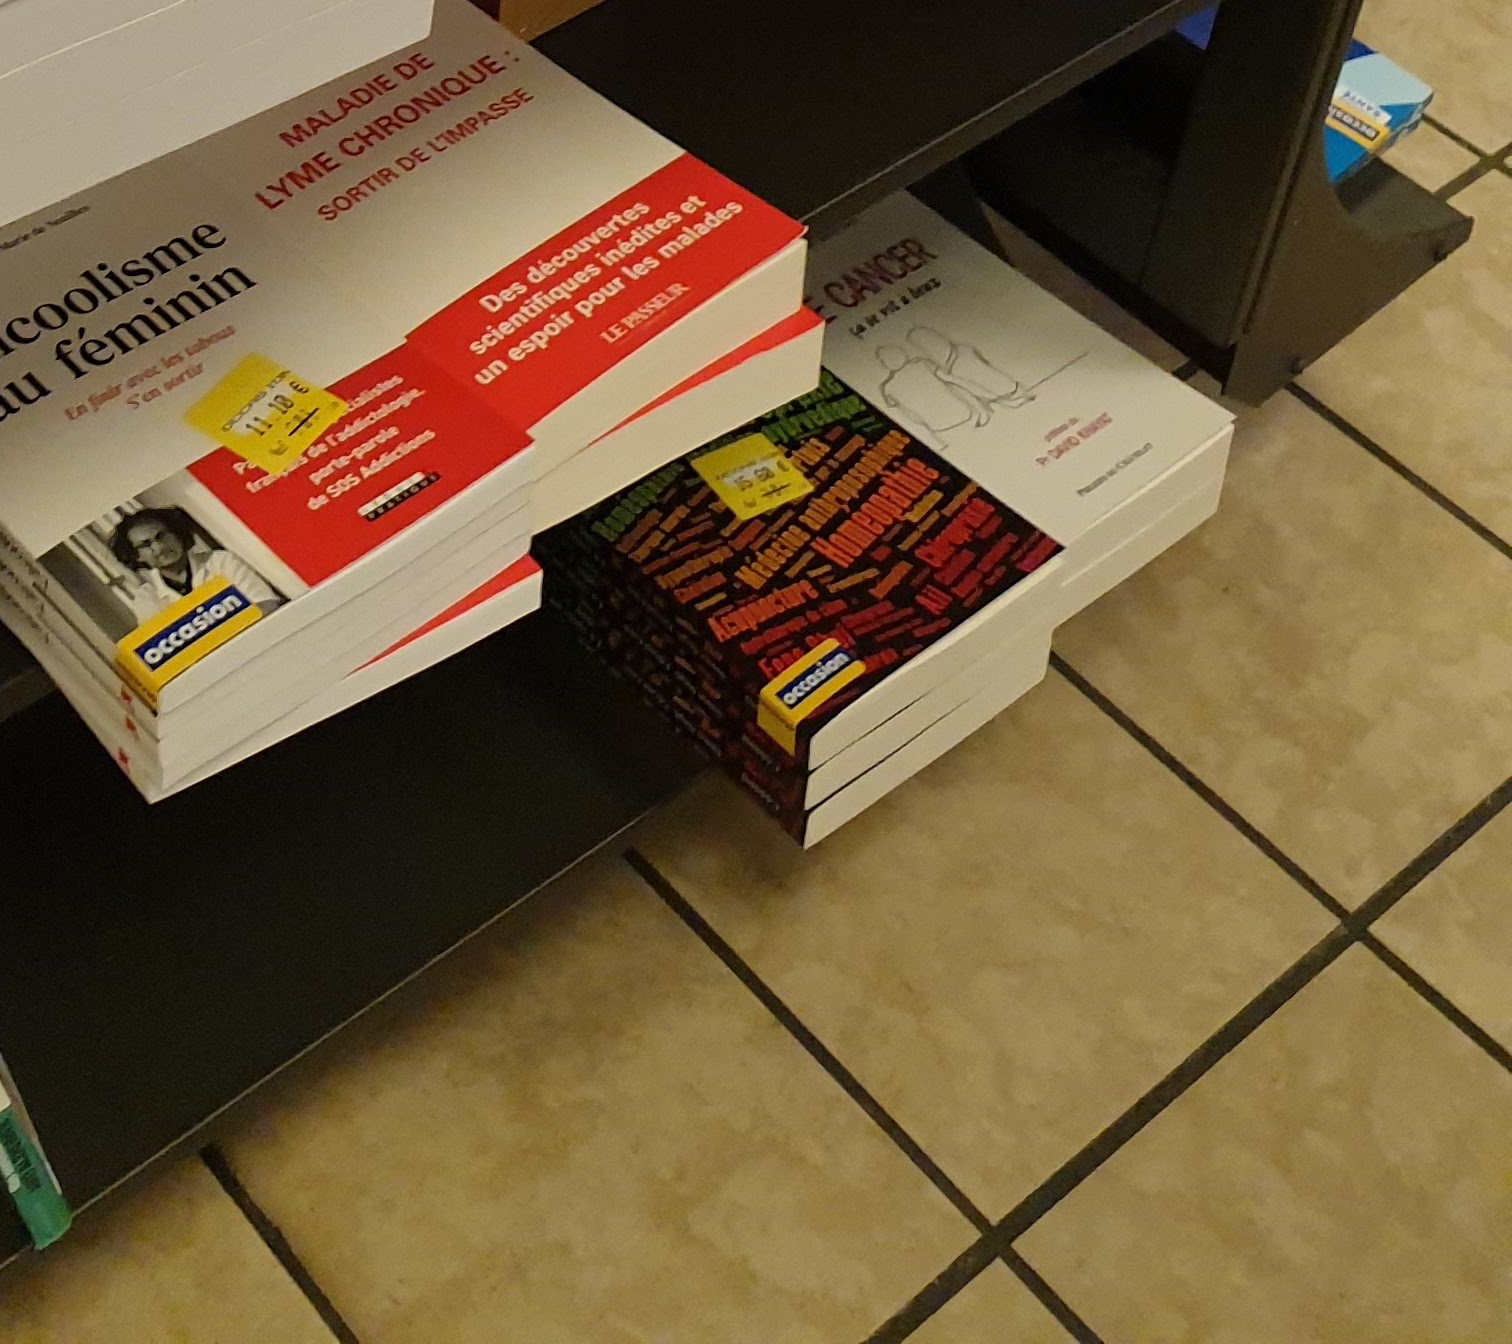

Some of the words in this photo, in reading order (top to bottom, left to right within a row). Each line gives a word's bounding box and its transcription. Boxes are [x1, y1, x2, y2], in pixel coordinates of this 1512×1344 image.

[254, 147, 342, 211] LYME
[337, 49, 508, 158] CHRONIQUE
[278, 70, 396, 149] MALADIE
[393, 52, 435, 83] DE
[317, 166, 400, 222] SORTIR
[396, 145, 431, 175] DE
[427, 87, 534, 154] L'IMPASSE
[469, 259, 601, 357] scientifiques
[600, 210, 682, 268] inédites
[680, 194, 707, 215] et
[474, 359, 508, 386] un
[507, 309, 575, 365] espoir
[576, 275, 625, 318] pour
[624, 254, 660, 282] les
[658, 199, 743, 260] malades
[479, 282, 528, 314] Des
[526, 200, 650, 286] découvertes
[600, 323, 625, 345] LE
[623, 280, 690, 330] PASSEUR
[823, 237, 938, 308] CANCER
[54, 262, 258, 381] féminin
[142, 591, 244, 665] occasion
[783, 652, 849, 705] occasion
